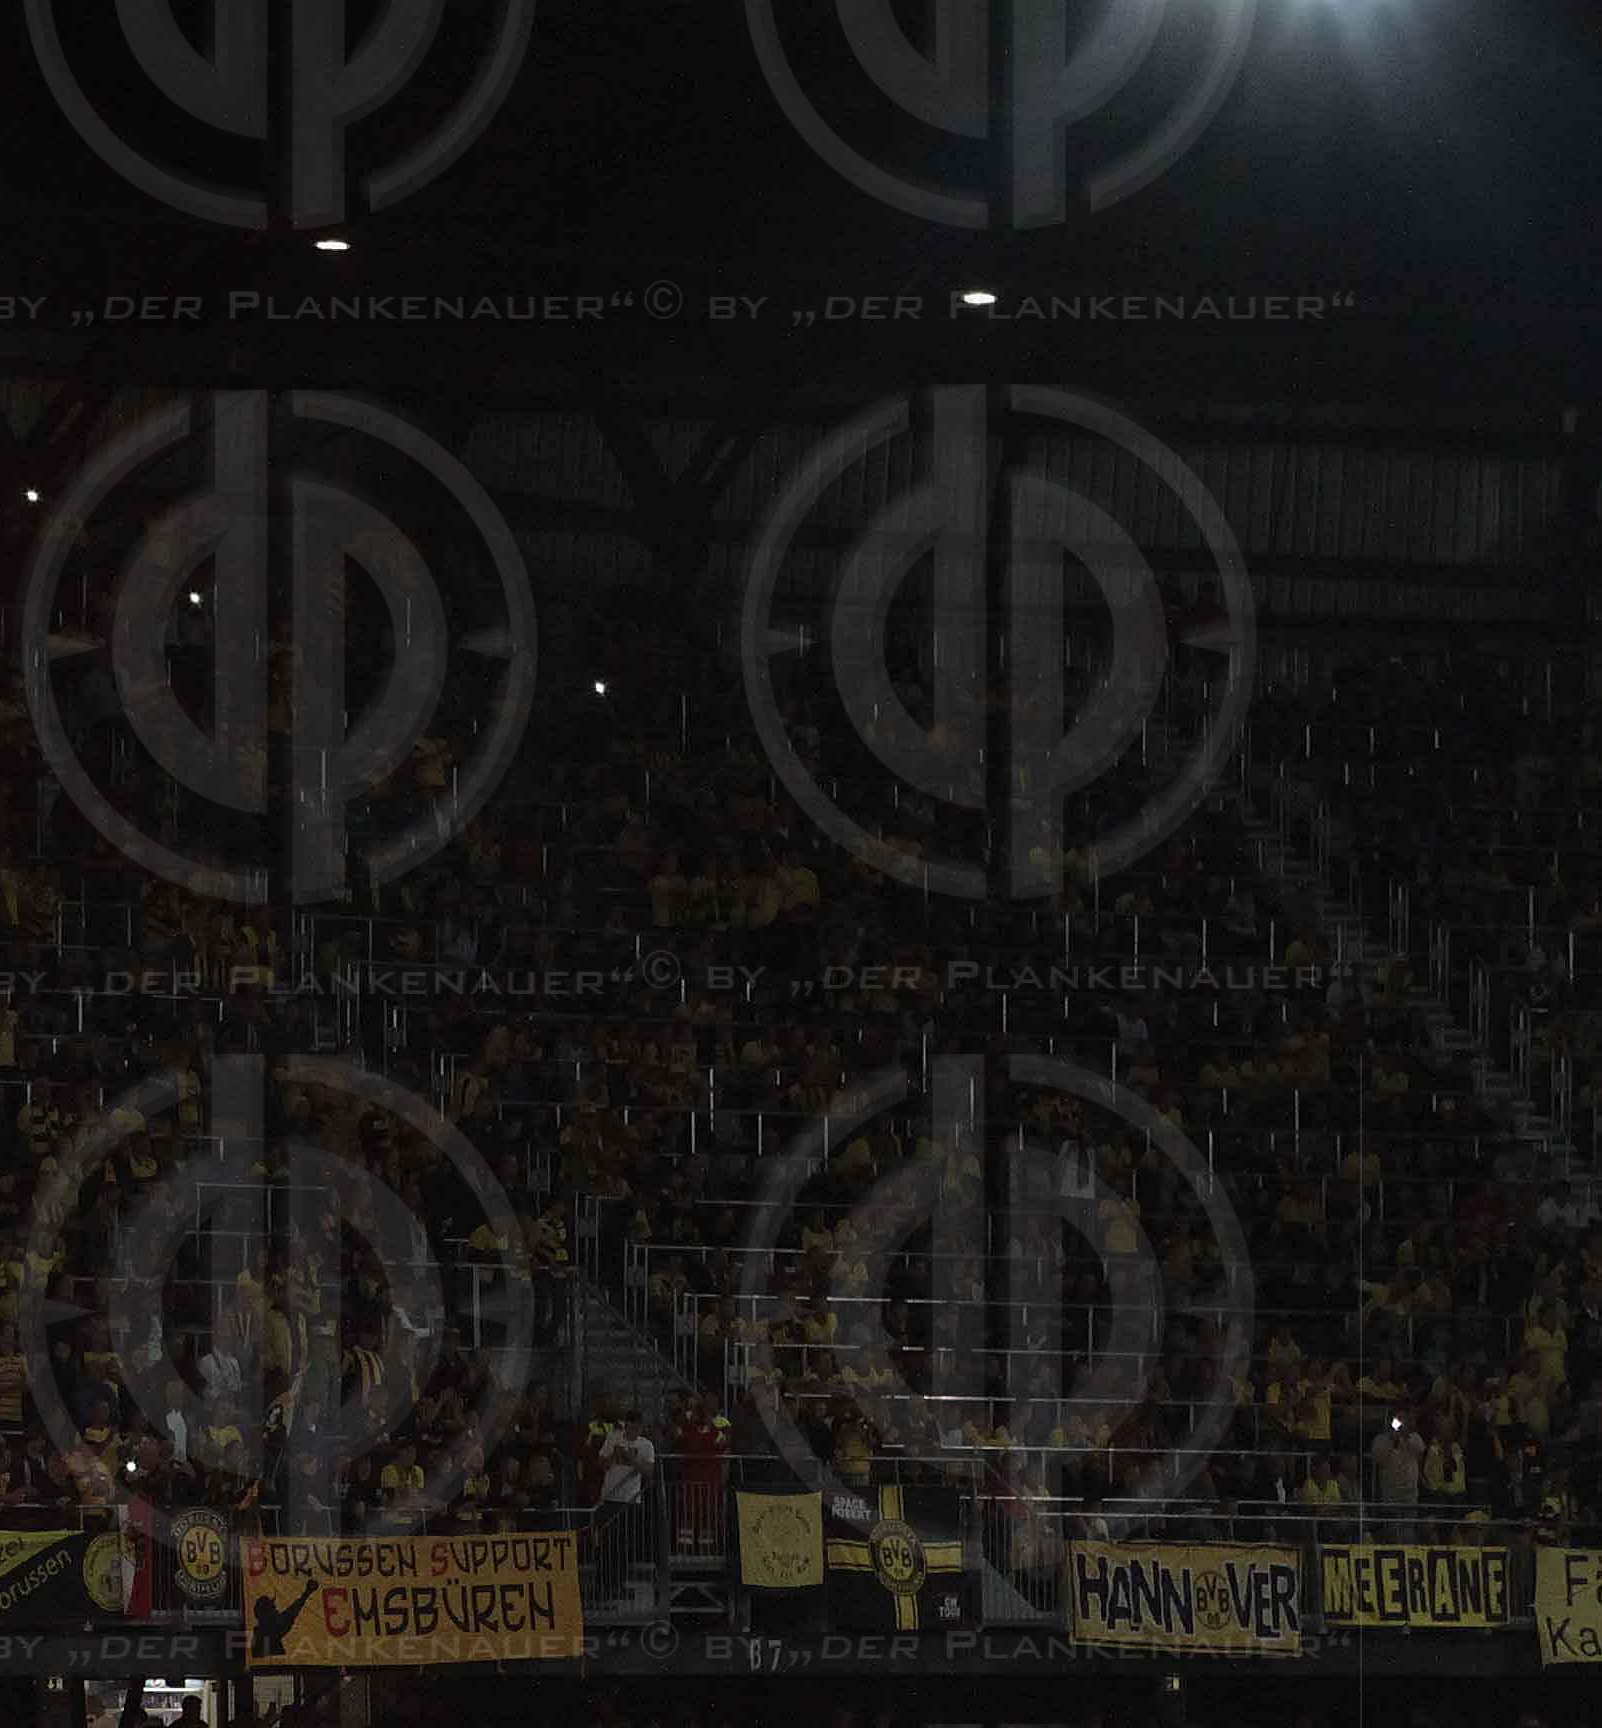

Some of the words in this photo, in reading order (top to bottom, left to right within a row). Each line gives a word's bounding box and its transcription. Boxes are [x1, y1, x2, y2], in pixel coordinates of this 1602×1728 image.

[247, 1538, 417, 1578] BORUSSEN
[431, 1535, 572, 1577] SUPPORT
[1321, 1547, 1510, 1621] MEERANE
[322, 1582, 556, 1640] EMSBÜREN
